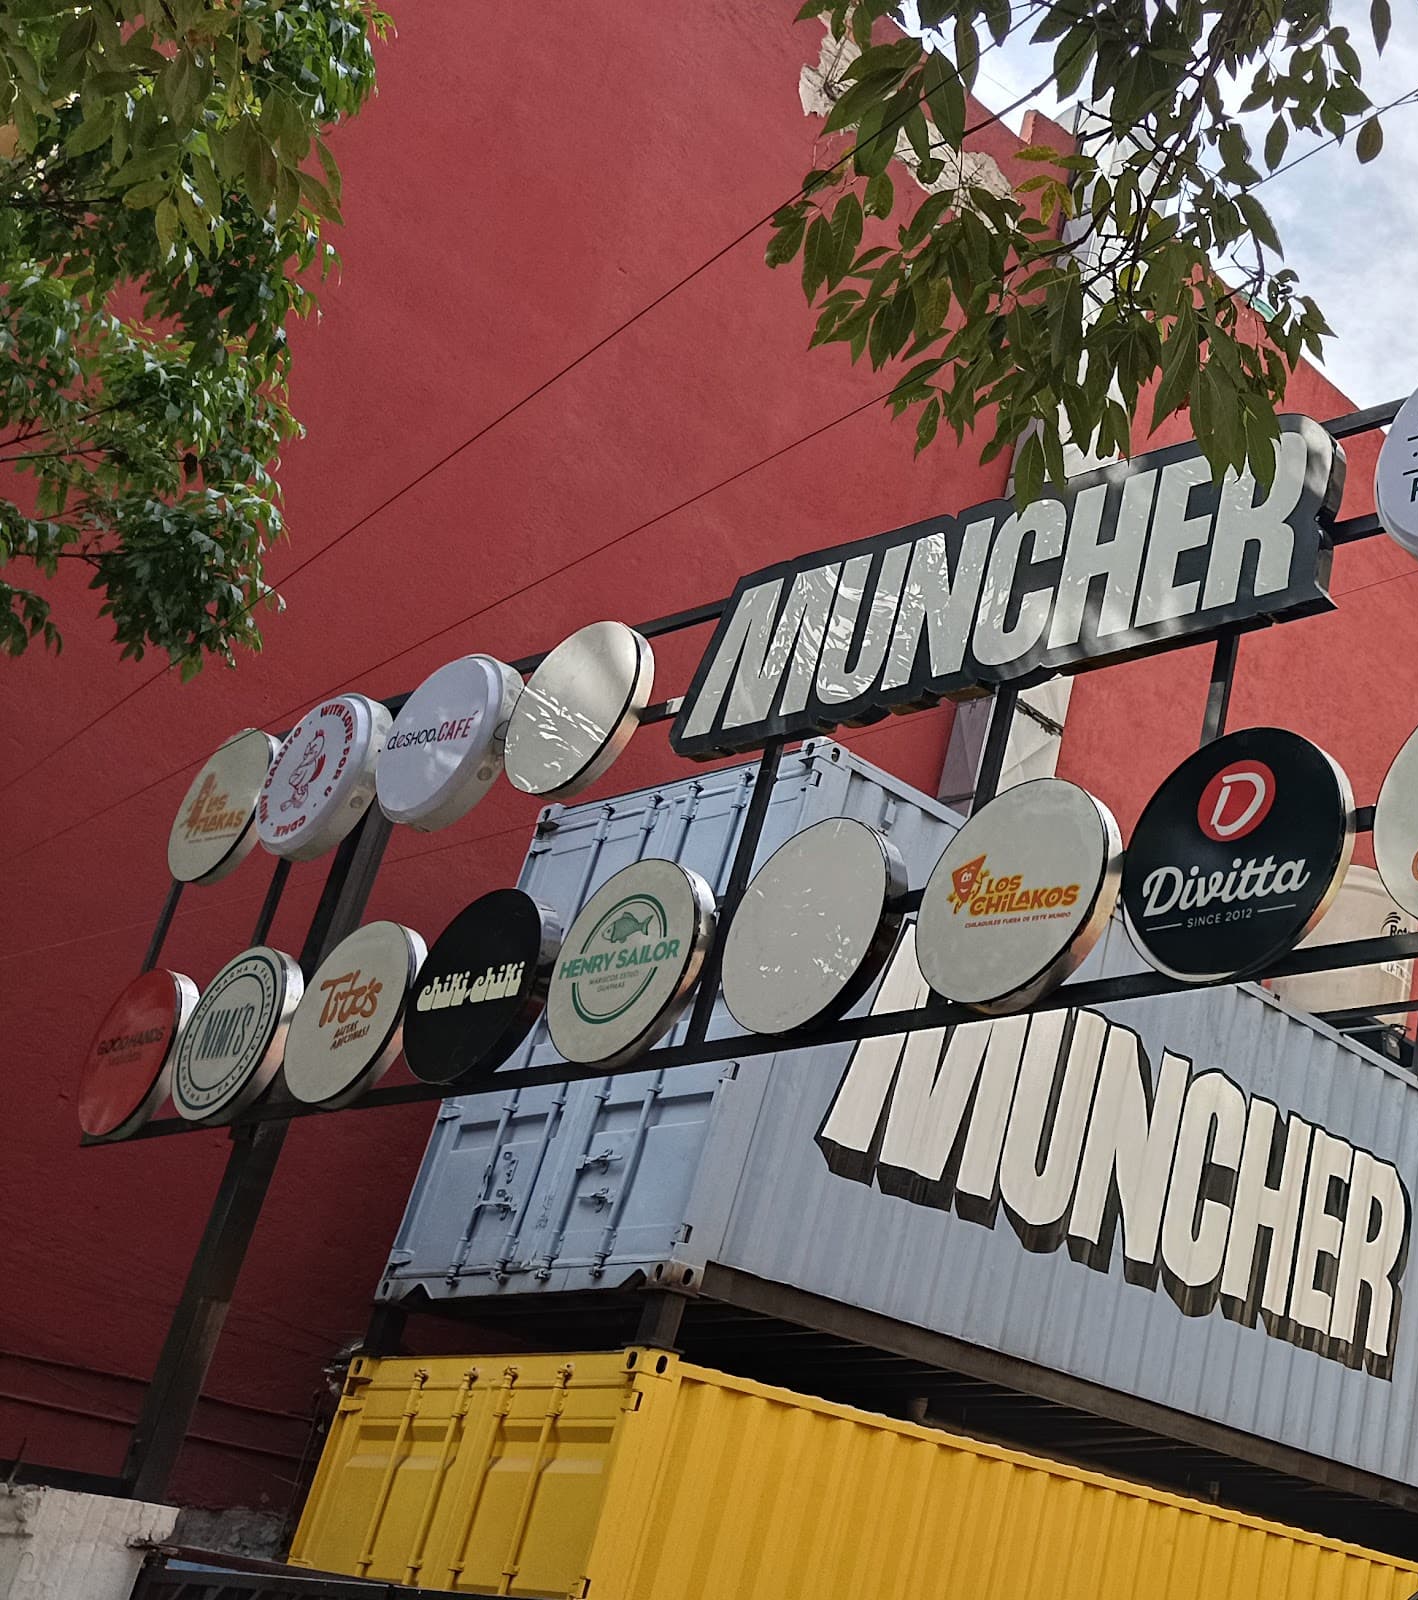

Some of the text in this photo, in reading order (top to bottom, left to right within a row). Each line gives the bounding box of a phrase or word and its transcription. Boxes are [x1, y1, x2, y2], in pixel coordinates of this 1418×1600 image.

[682, 431, 1309, 739] MUNCHER
[320, 704, 345, 718] WITH
[341, 711, 354, 744] LOVE
[259, 726, 302, 824] MUY GALLITO
[324, 785, 332, 797] U
[273, 815, 306, 837] CDMX
[985, 874, 1023, 894] LOS
[1142, 855, 1311, 917] Divitta
[1002, 917, 1021, 925] FUERA
[1048, 912, 1072, 920] MUNDO
[1187, 908, 1253, 928] SINCE 2012
[558, 939, 681, 980] HENRY SAILOR
